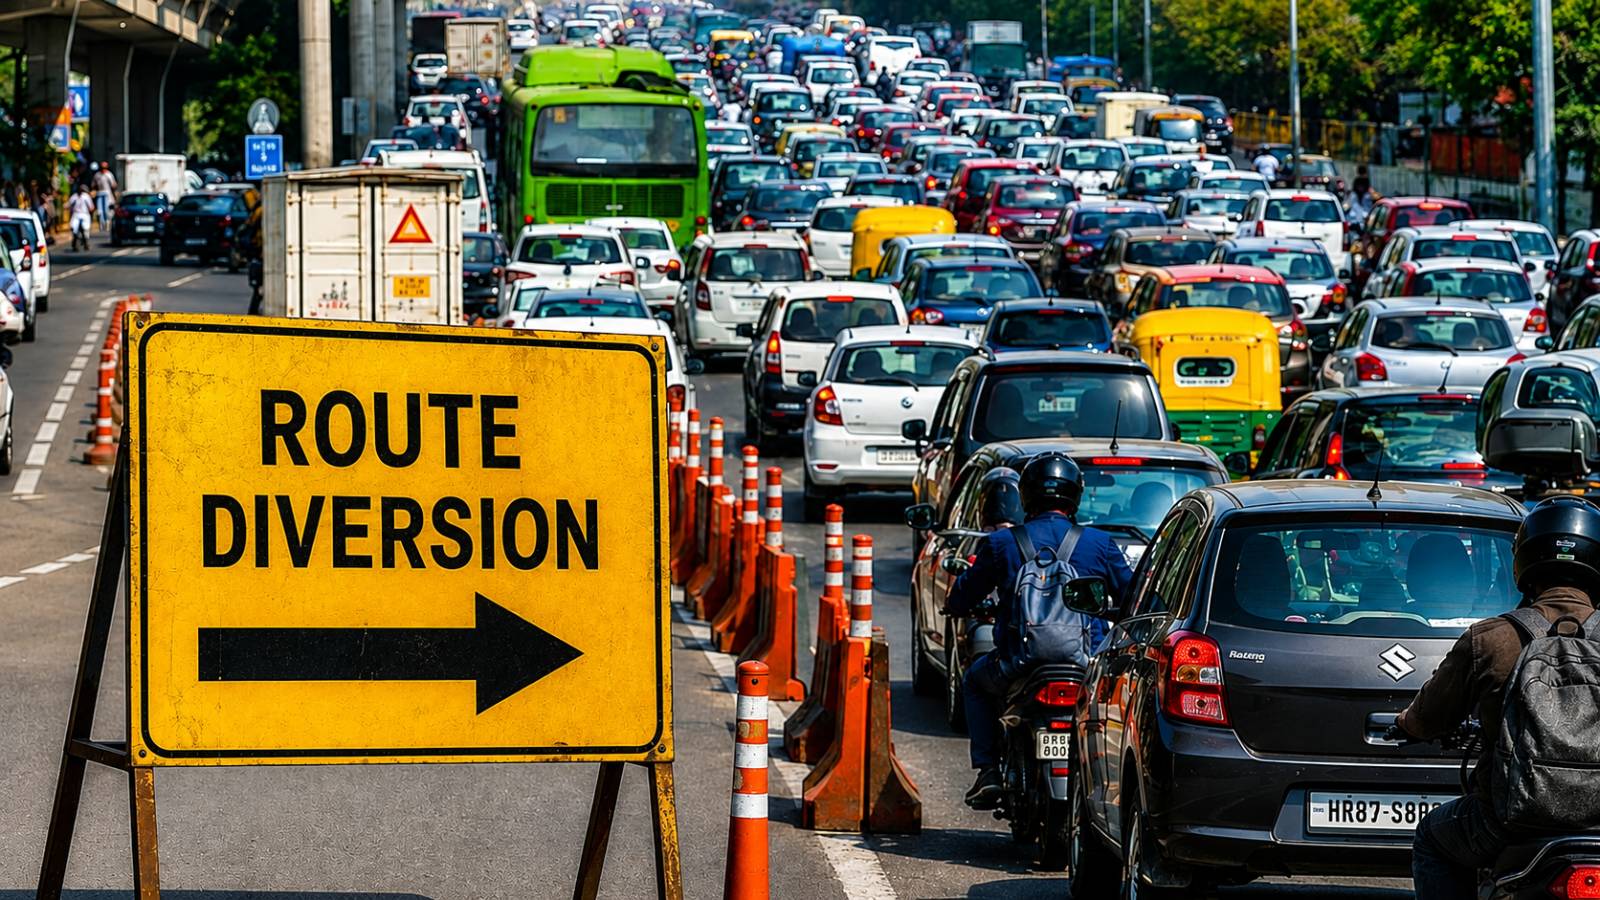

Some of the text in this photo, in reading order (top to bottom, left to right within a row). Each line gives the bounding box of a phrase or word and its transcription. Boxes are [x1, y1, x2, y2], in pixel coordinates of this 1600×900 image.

[260, 388, 521, 470] ROUTE
[202, 494, 599, 570] DIVERSION
[1328, 799, 1442, 824] HR87-S8
